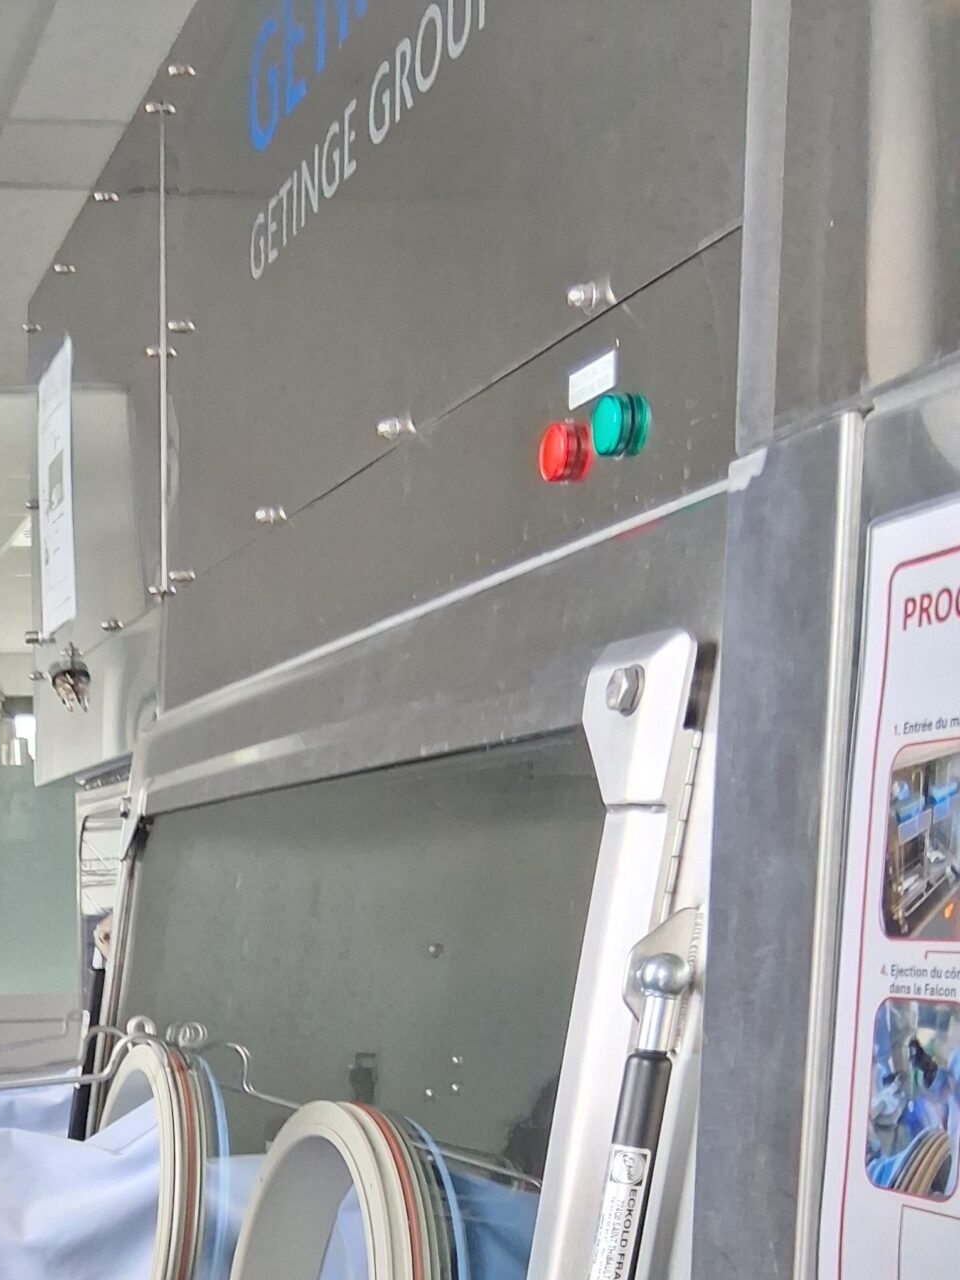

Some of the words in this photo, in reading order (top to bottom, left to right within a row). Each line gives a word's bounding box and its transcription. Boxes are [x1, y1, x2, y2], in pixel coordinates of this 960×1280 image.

[250, 98, 357, 280] GETINGE
[903, 718, 933, 735] Entrée
[935, 716, 948, 730] du
[890, 964, 928, 979] Ejection
[930, 966, 942, 979] du
[889, 982, 911, 994] dans
[913, 982, 922, 995] le
[924, 983, 957, 998] Falcon
[619, 1188, 638, 1248] ECKOLD
